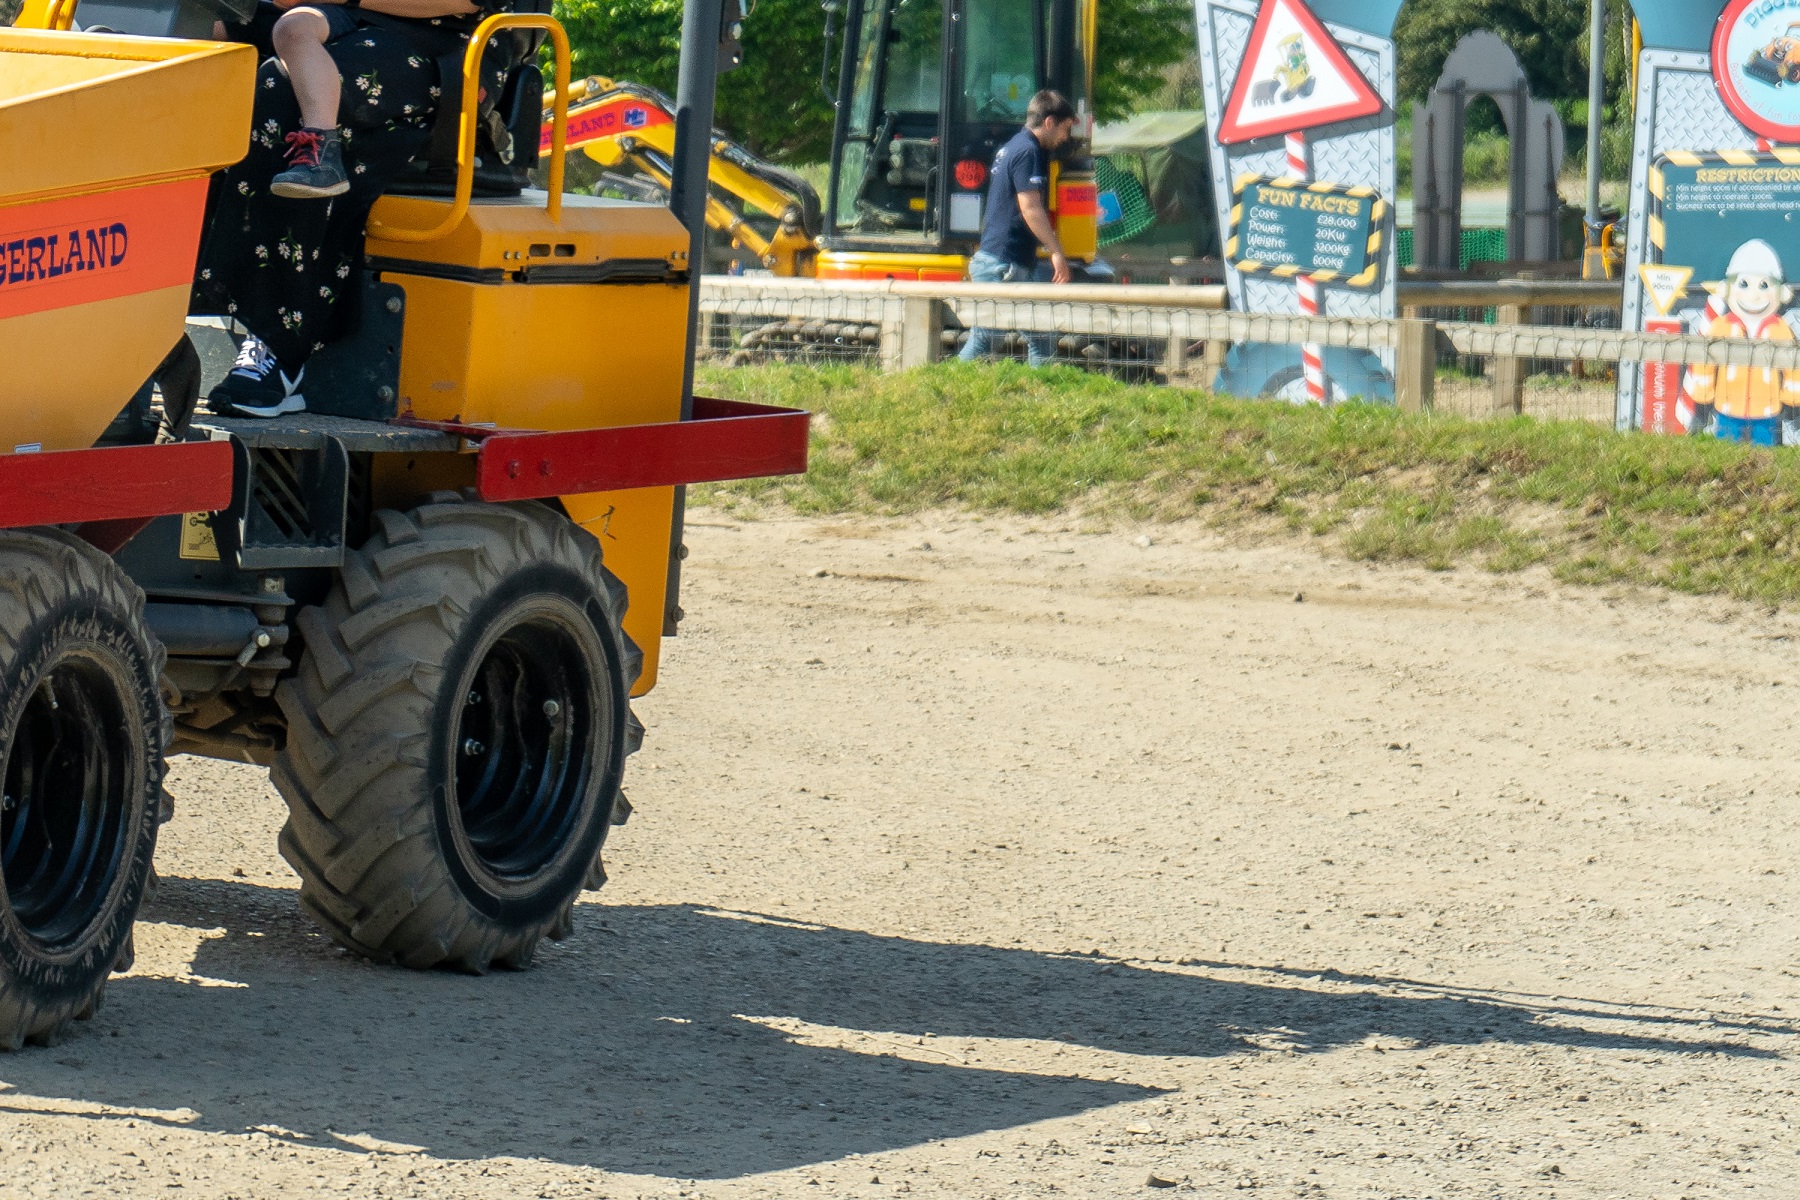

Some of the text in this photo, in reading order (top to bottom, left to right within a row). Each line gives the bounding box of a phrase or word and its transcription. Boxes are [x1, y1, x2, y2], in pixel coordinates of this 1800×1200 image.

[1696, 168, 1800, 183] RESTRICTION
[1258, 188, 1360, 216] FUN FACTS
